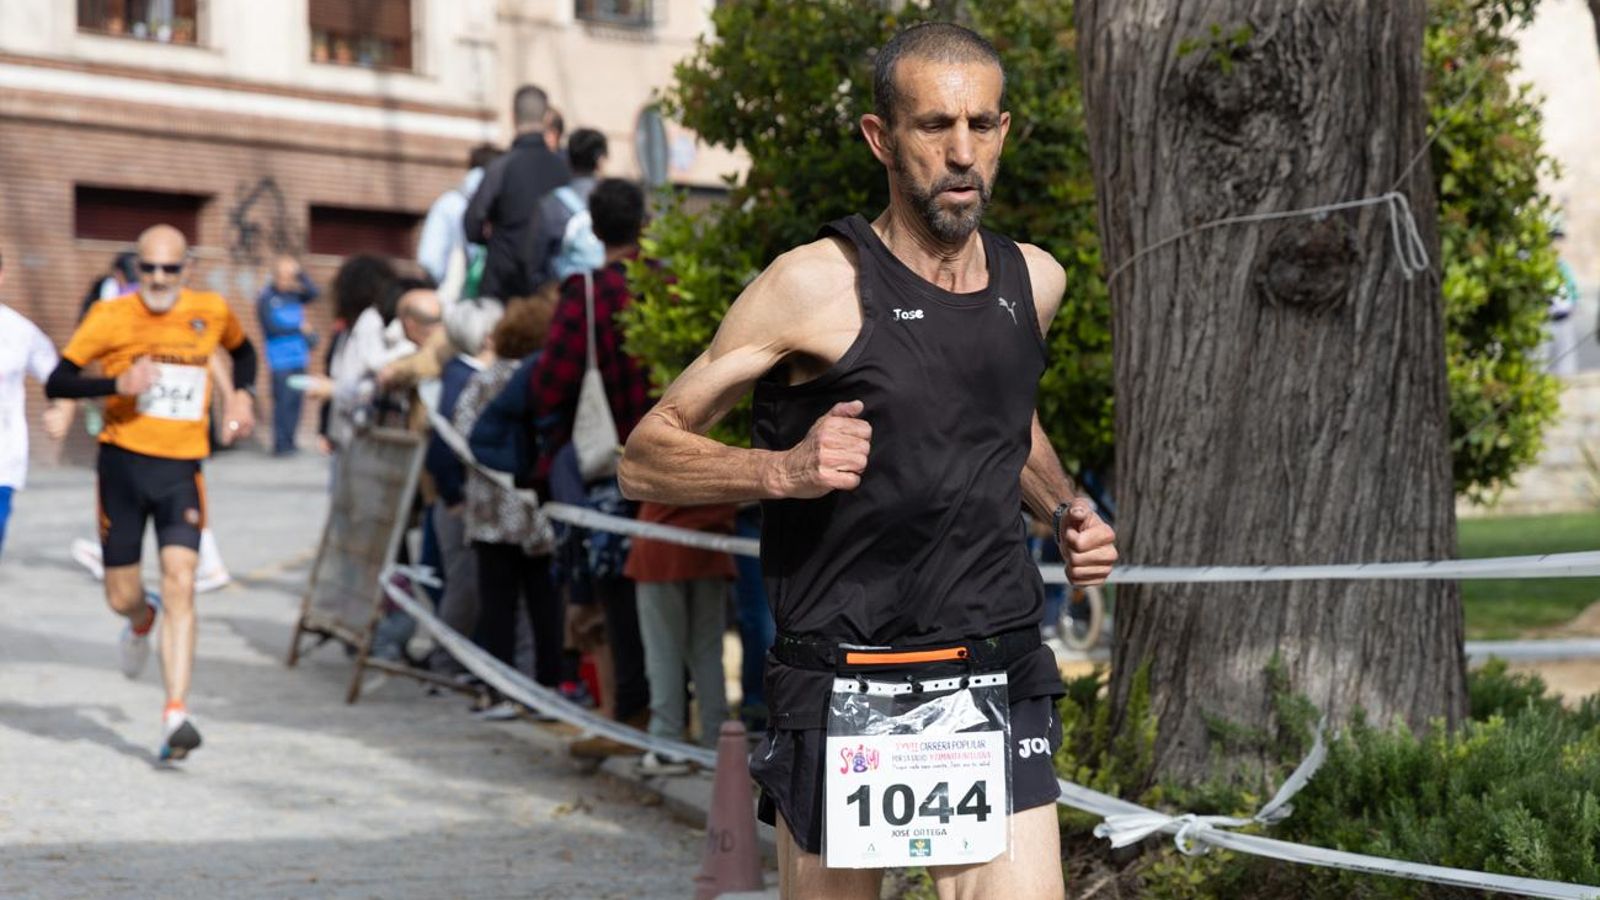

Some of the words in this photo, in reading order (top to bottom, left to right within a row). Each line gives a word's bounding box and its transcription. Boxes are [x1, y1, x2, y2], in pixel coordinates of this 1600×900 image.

[893, 308, 924, 321] Jose
[920, 741, 951, 752] CARRERA
[951, 739, 986, 750] POPULAR
[846, 780, 992, 827] 1044
[891, 829, 910, 837] JOSE
[913, 828, 947, 837] ORTEGA
